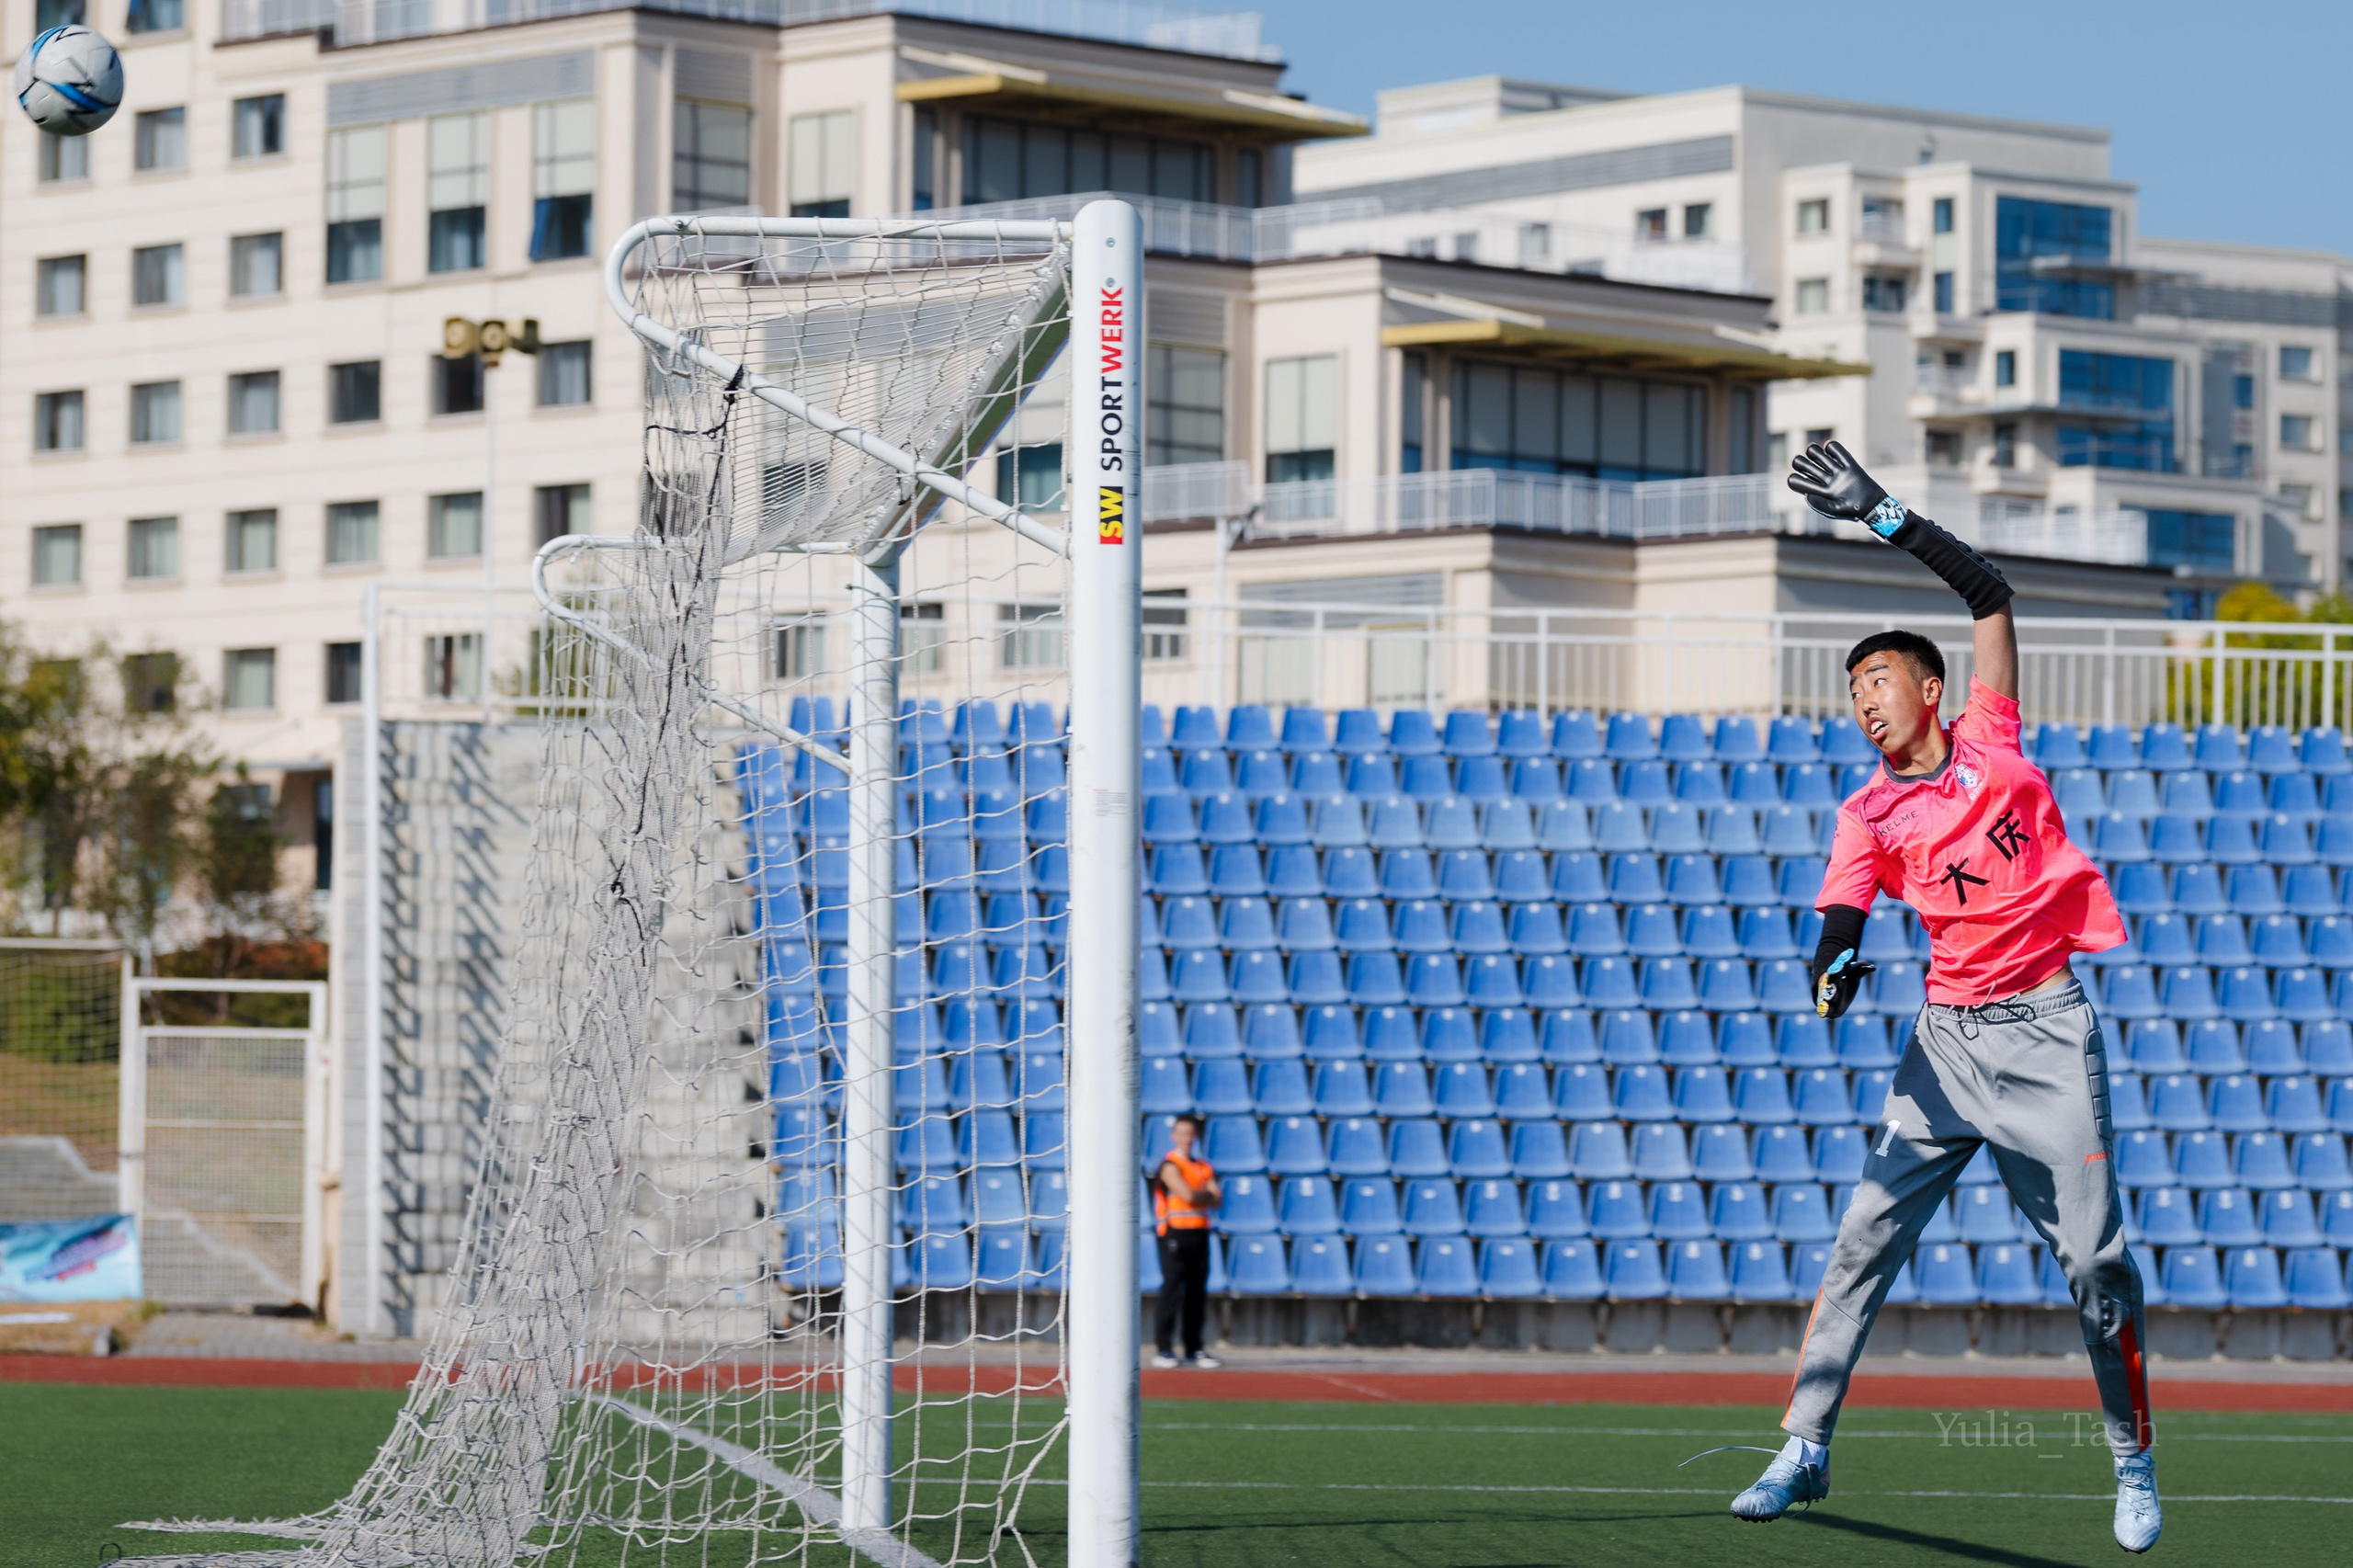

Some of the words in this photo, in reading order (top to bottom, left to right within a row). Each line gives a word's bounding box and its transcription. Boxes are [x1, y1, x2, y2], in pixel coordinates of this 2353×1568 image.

[1100, 287, 1123, 472] SPORTWERK
[1099, 488, 1123, 539] SW
[1878, 810, 1919, 837] KELME
[1874, 1119, 1902, 1157] 1
